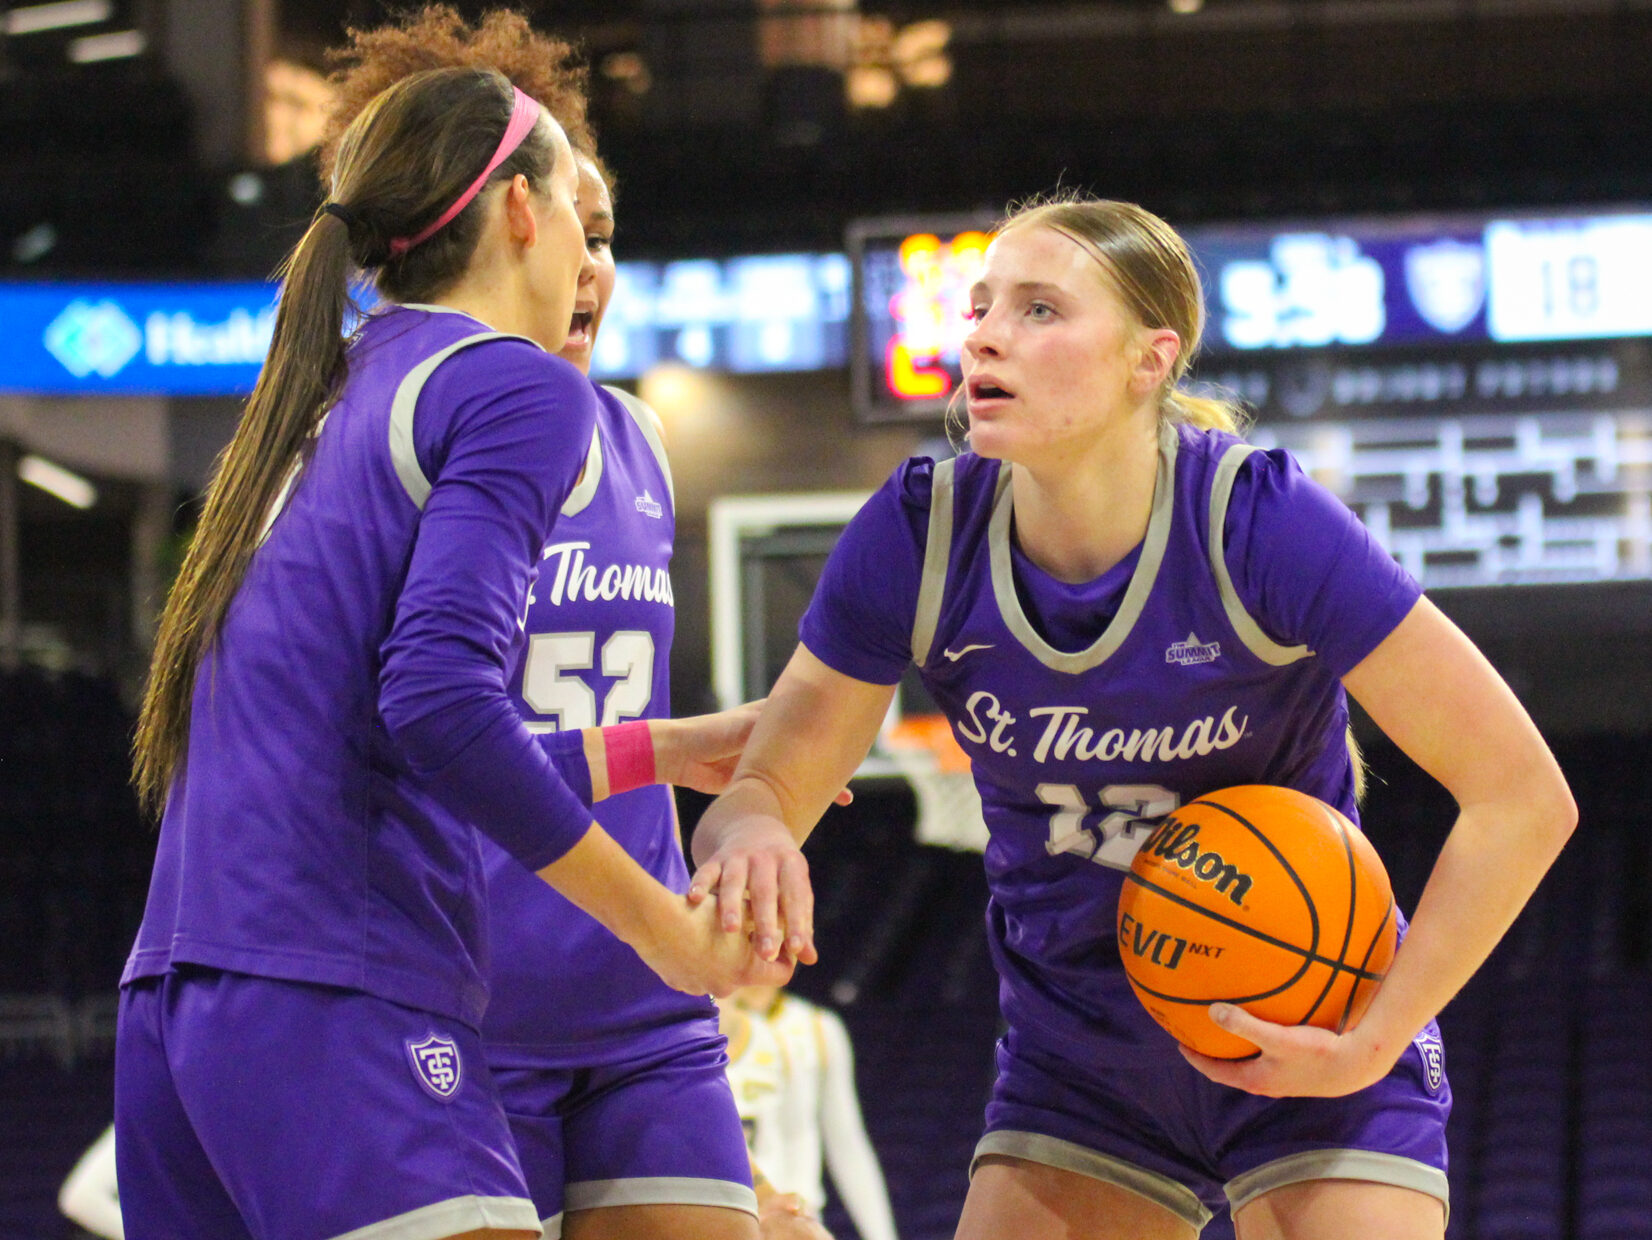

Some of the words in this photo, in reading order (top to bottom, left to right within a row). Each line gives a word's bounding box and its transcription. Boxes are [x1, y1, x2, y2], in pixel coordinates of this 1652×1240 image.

[521, 631, 655, 734] 52
[1167, 644, 1220, 662] SUMMIT
[957, 690, 1017, 757] St.
[1029, 706, 1248, 763] Thomas
[1034, 782, 1181, 872] 12
[1188, 943, 1225, 959] NXT
